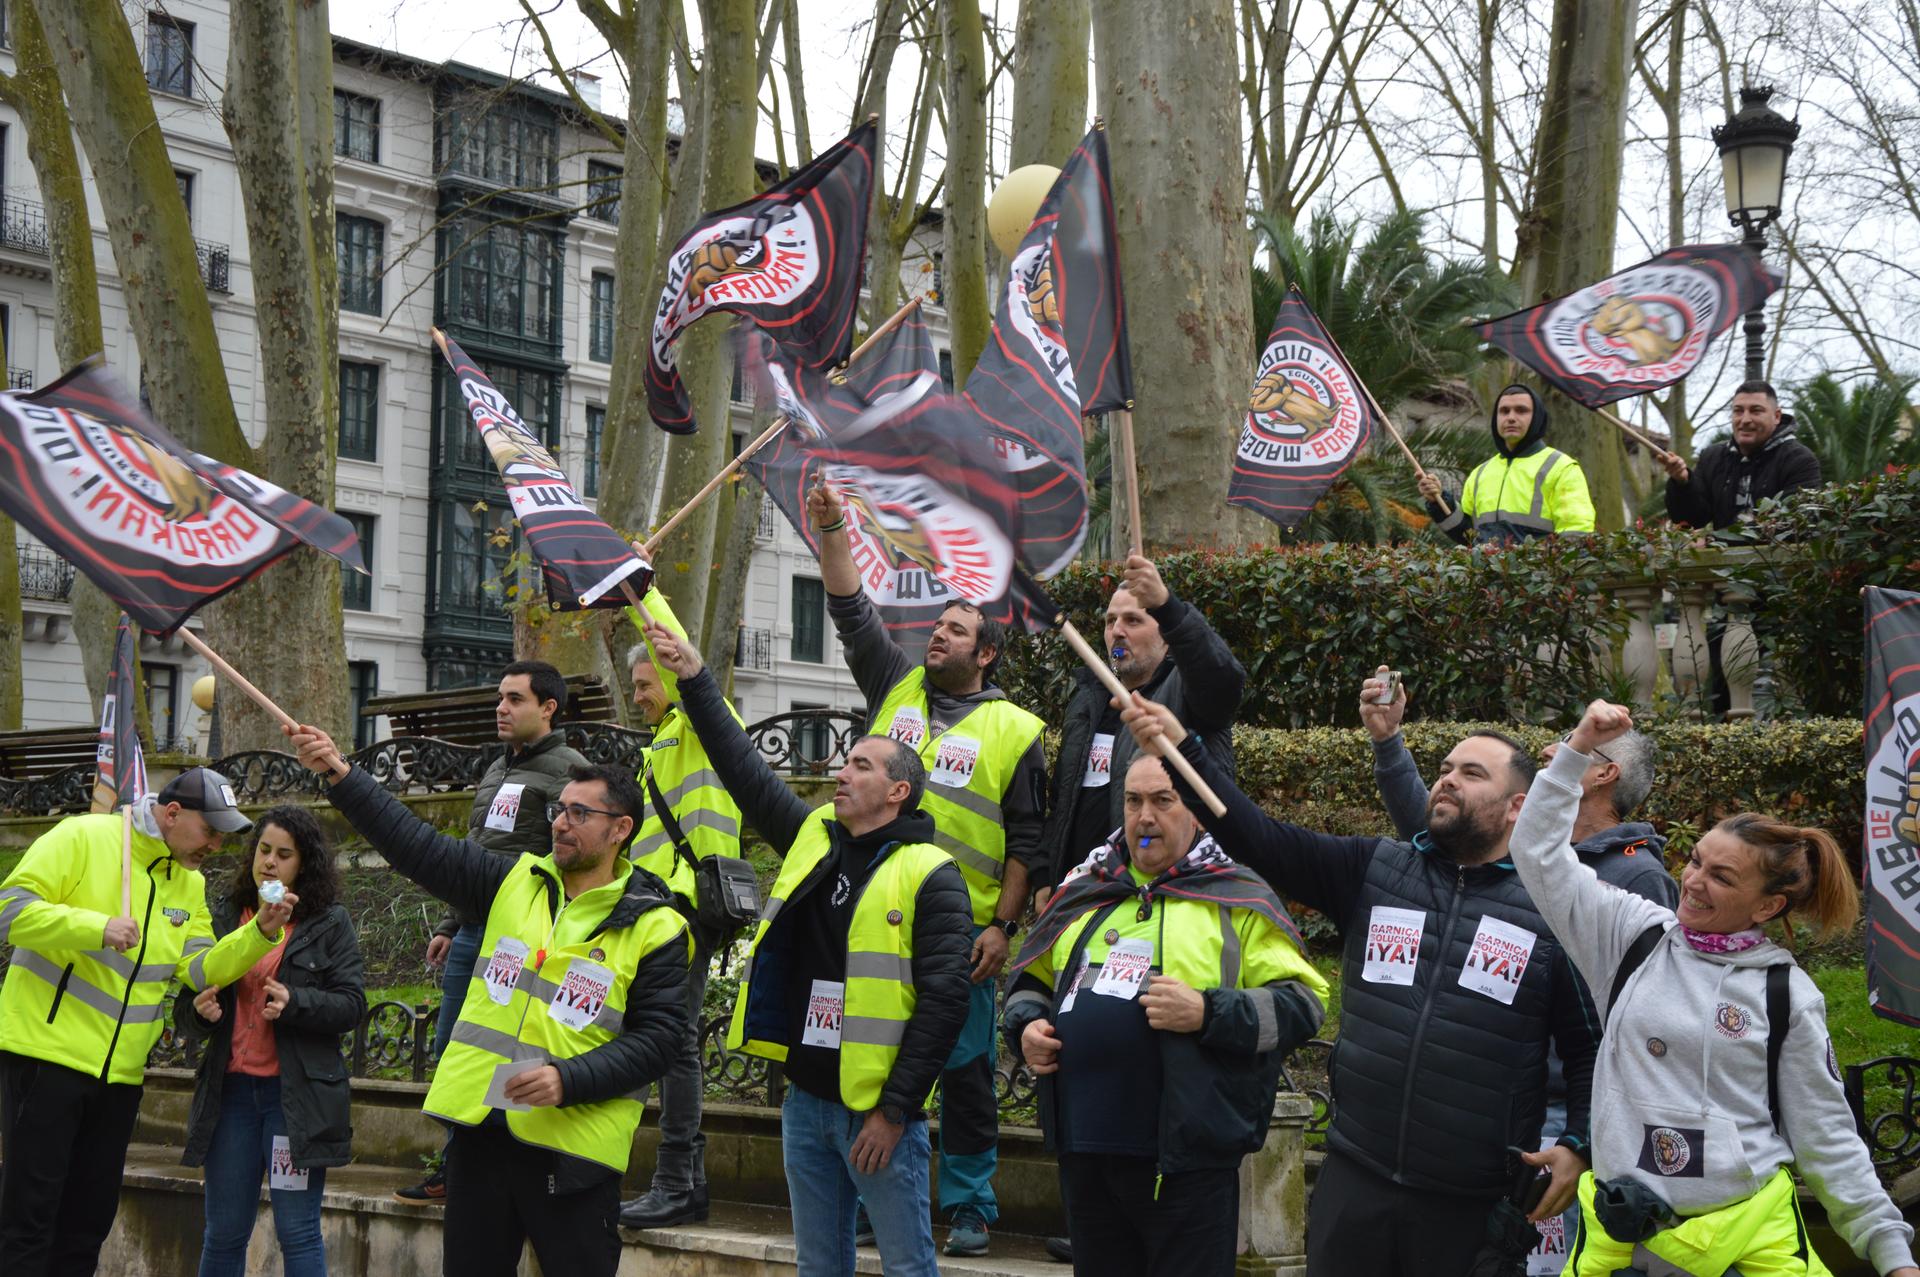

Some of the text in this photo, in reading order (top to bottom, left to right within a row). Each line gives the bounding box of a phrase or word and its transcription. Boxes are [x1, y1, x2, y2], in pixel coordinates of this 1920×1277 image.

[940, 743, 977, 757] GARNICA
[935, 755, 974, 776] ¡YA!
[1371, 924, 1420, 937] GARNICA
[1367, 943, 1418, 965] ¡YA!
[1476, 932, 1529, 958] GARNICA
[494, 951, 524, 966] GARNICA
[1109, 951, 1151, 964] GARNICA
[1467, 949, 1524, 984] ¡YA!
[486, 966, 518, 988] ¡YA!
[566, 970, 608, 994] GARNICA
[1100, 965, 1146, 984] ¡YA!
[555, 986, 604, 1017] ¡YA!
[811, 995, 842, 1006] GARNICA
[807, 1011, 842, 1031] ¡YA!
